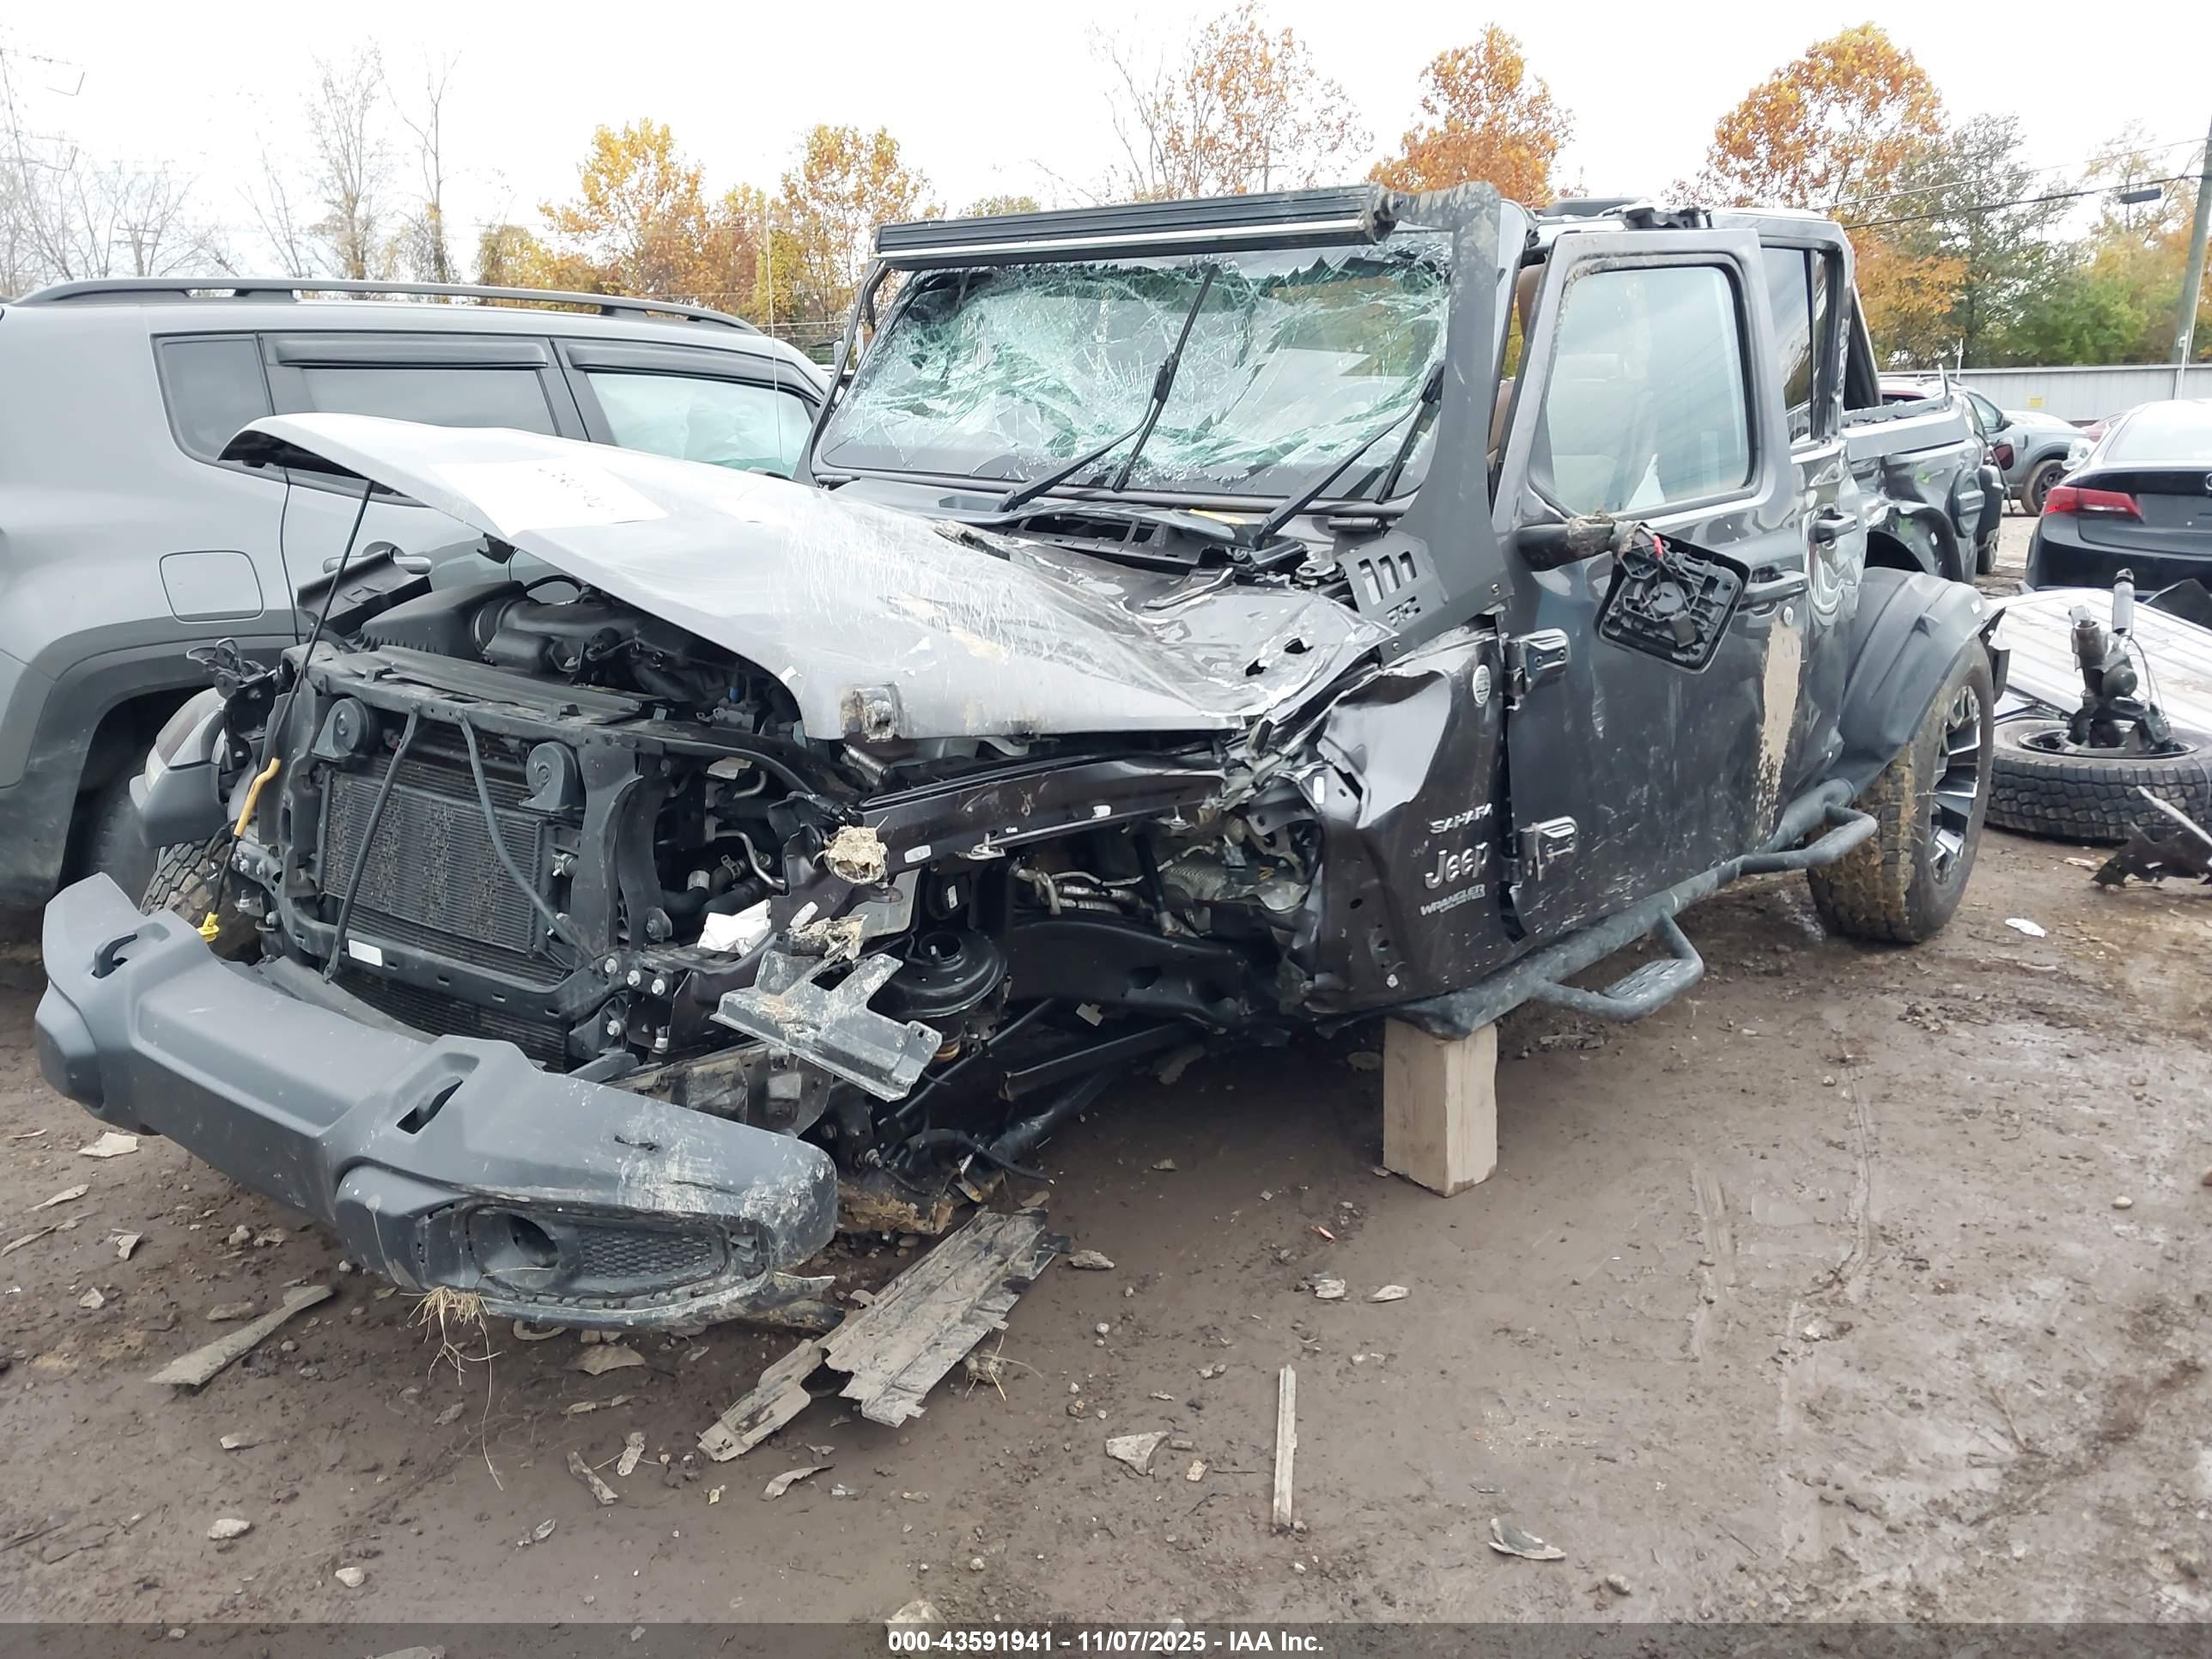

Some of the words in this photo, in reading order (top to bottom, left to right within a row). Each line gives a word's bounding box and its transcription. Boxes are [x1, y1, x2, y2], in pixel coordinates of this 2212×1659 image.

[1429, 802, 1492, 834] SAHARA
[1425, 842, 1491, 889] Jeep
[1419, 884, 1486, 916] WRANGLER
